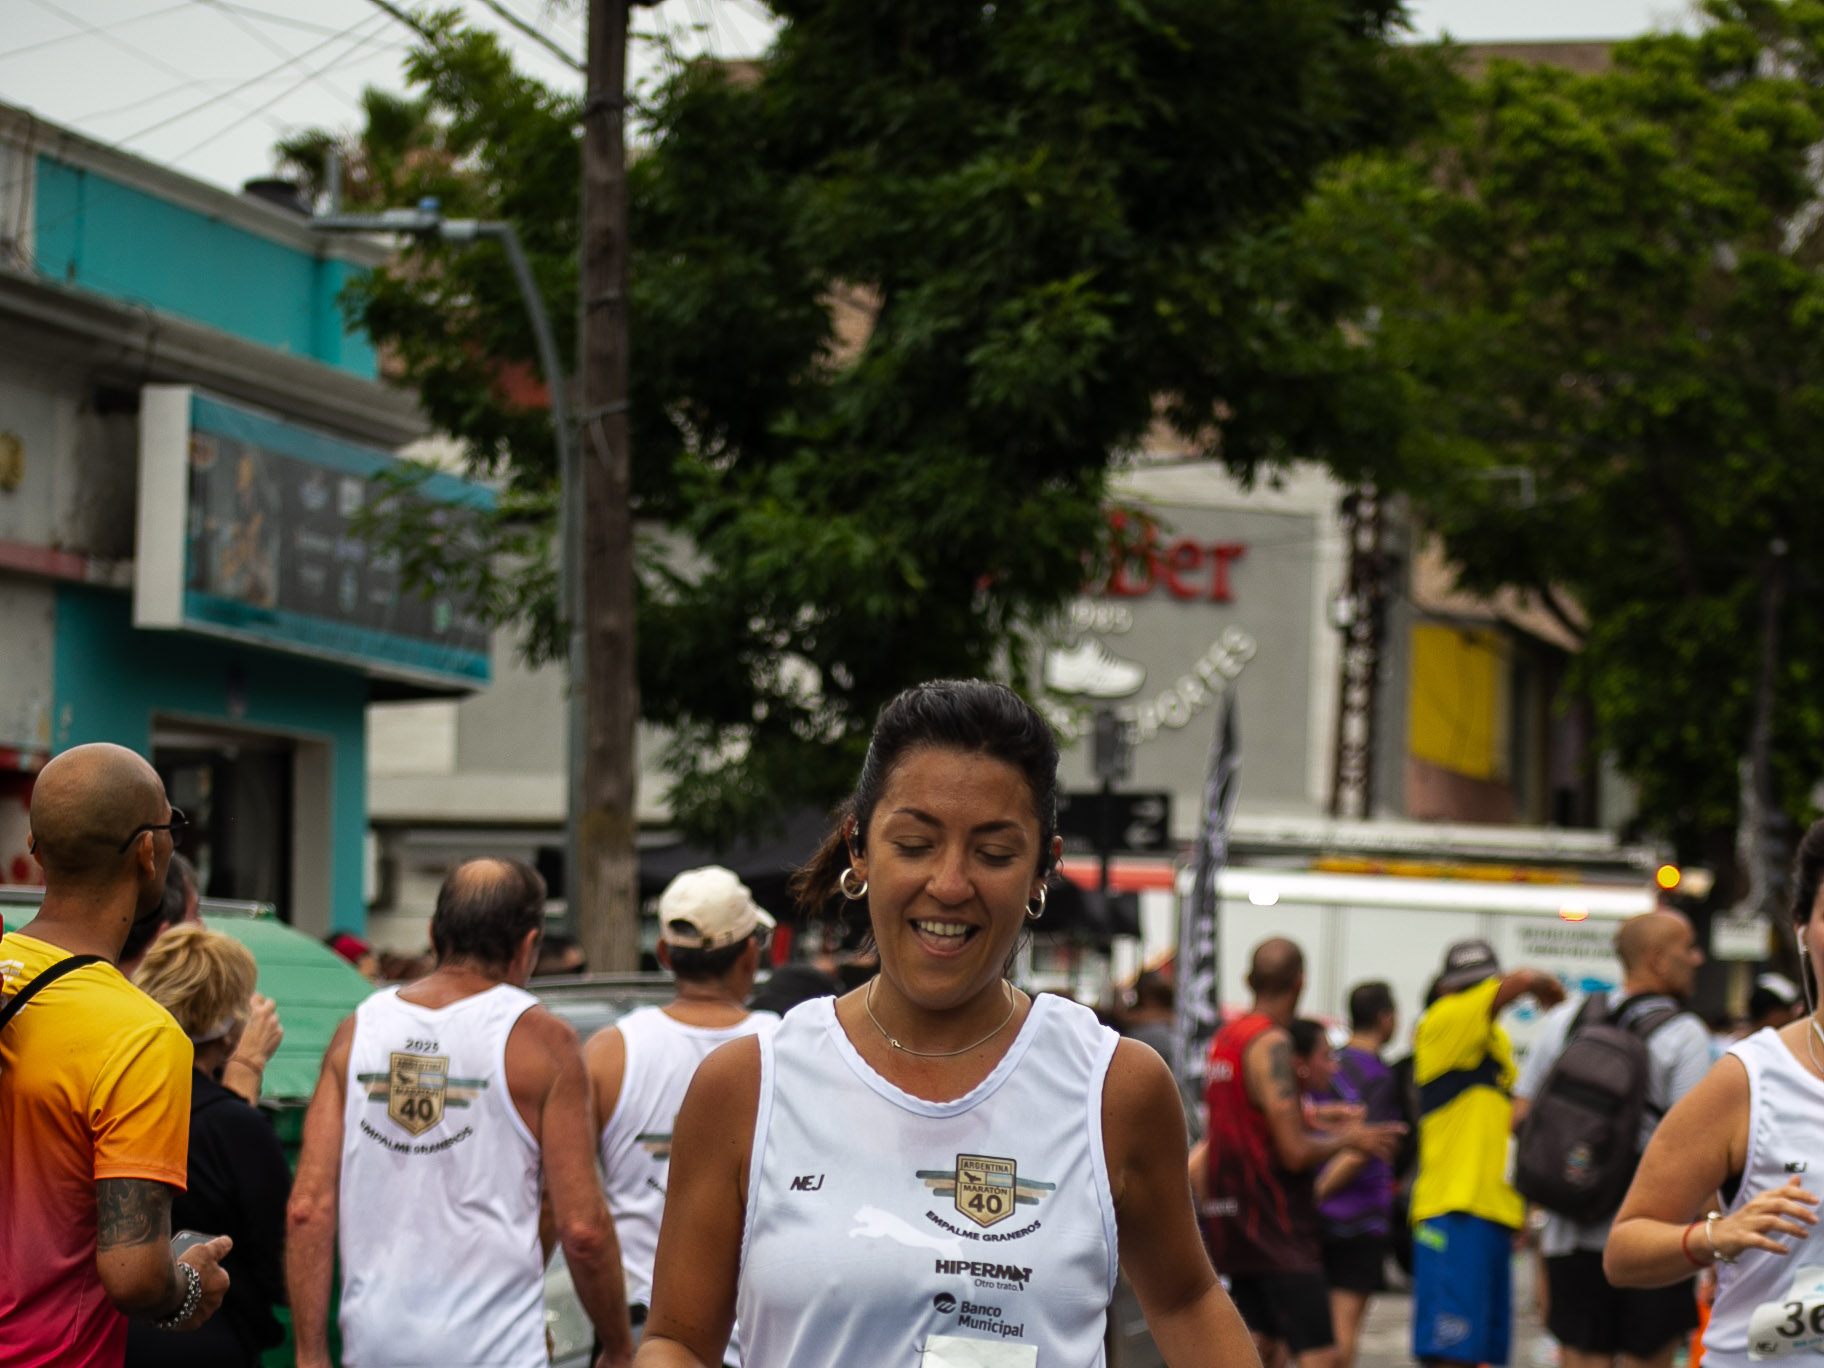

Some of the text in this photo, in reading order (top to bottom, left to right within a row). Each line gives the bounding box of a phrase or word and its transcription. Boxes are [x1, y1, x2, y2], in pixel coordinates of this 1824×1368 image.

[400, 1098, 434, 1122] 40
[963, 1161, 1009, 1173] ARGENTINA
[968, 1194, 1003, 1214] 40
[925, 1210, 1042, 1242] EMPALME GRANEROS
[974, 1278, 995, 1289] Otro
[960, 1301, 1002, 1318] Banco
[957, 1315, 1025, 1338] Municipal
